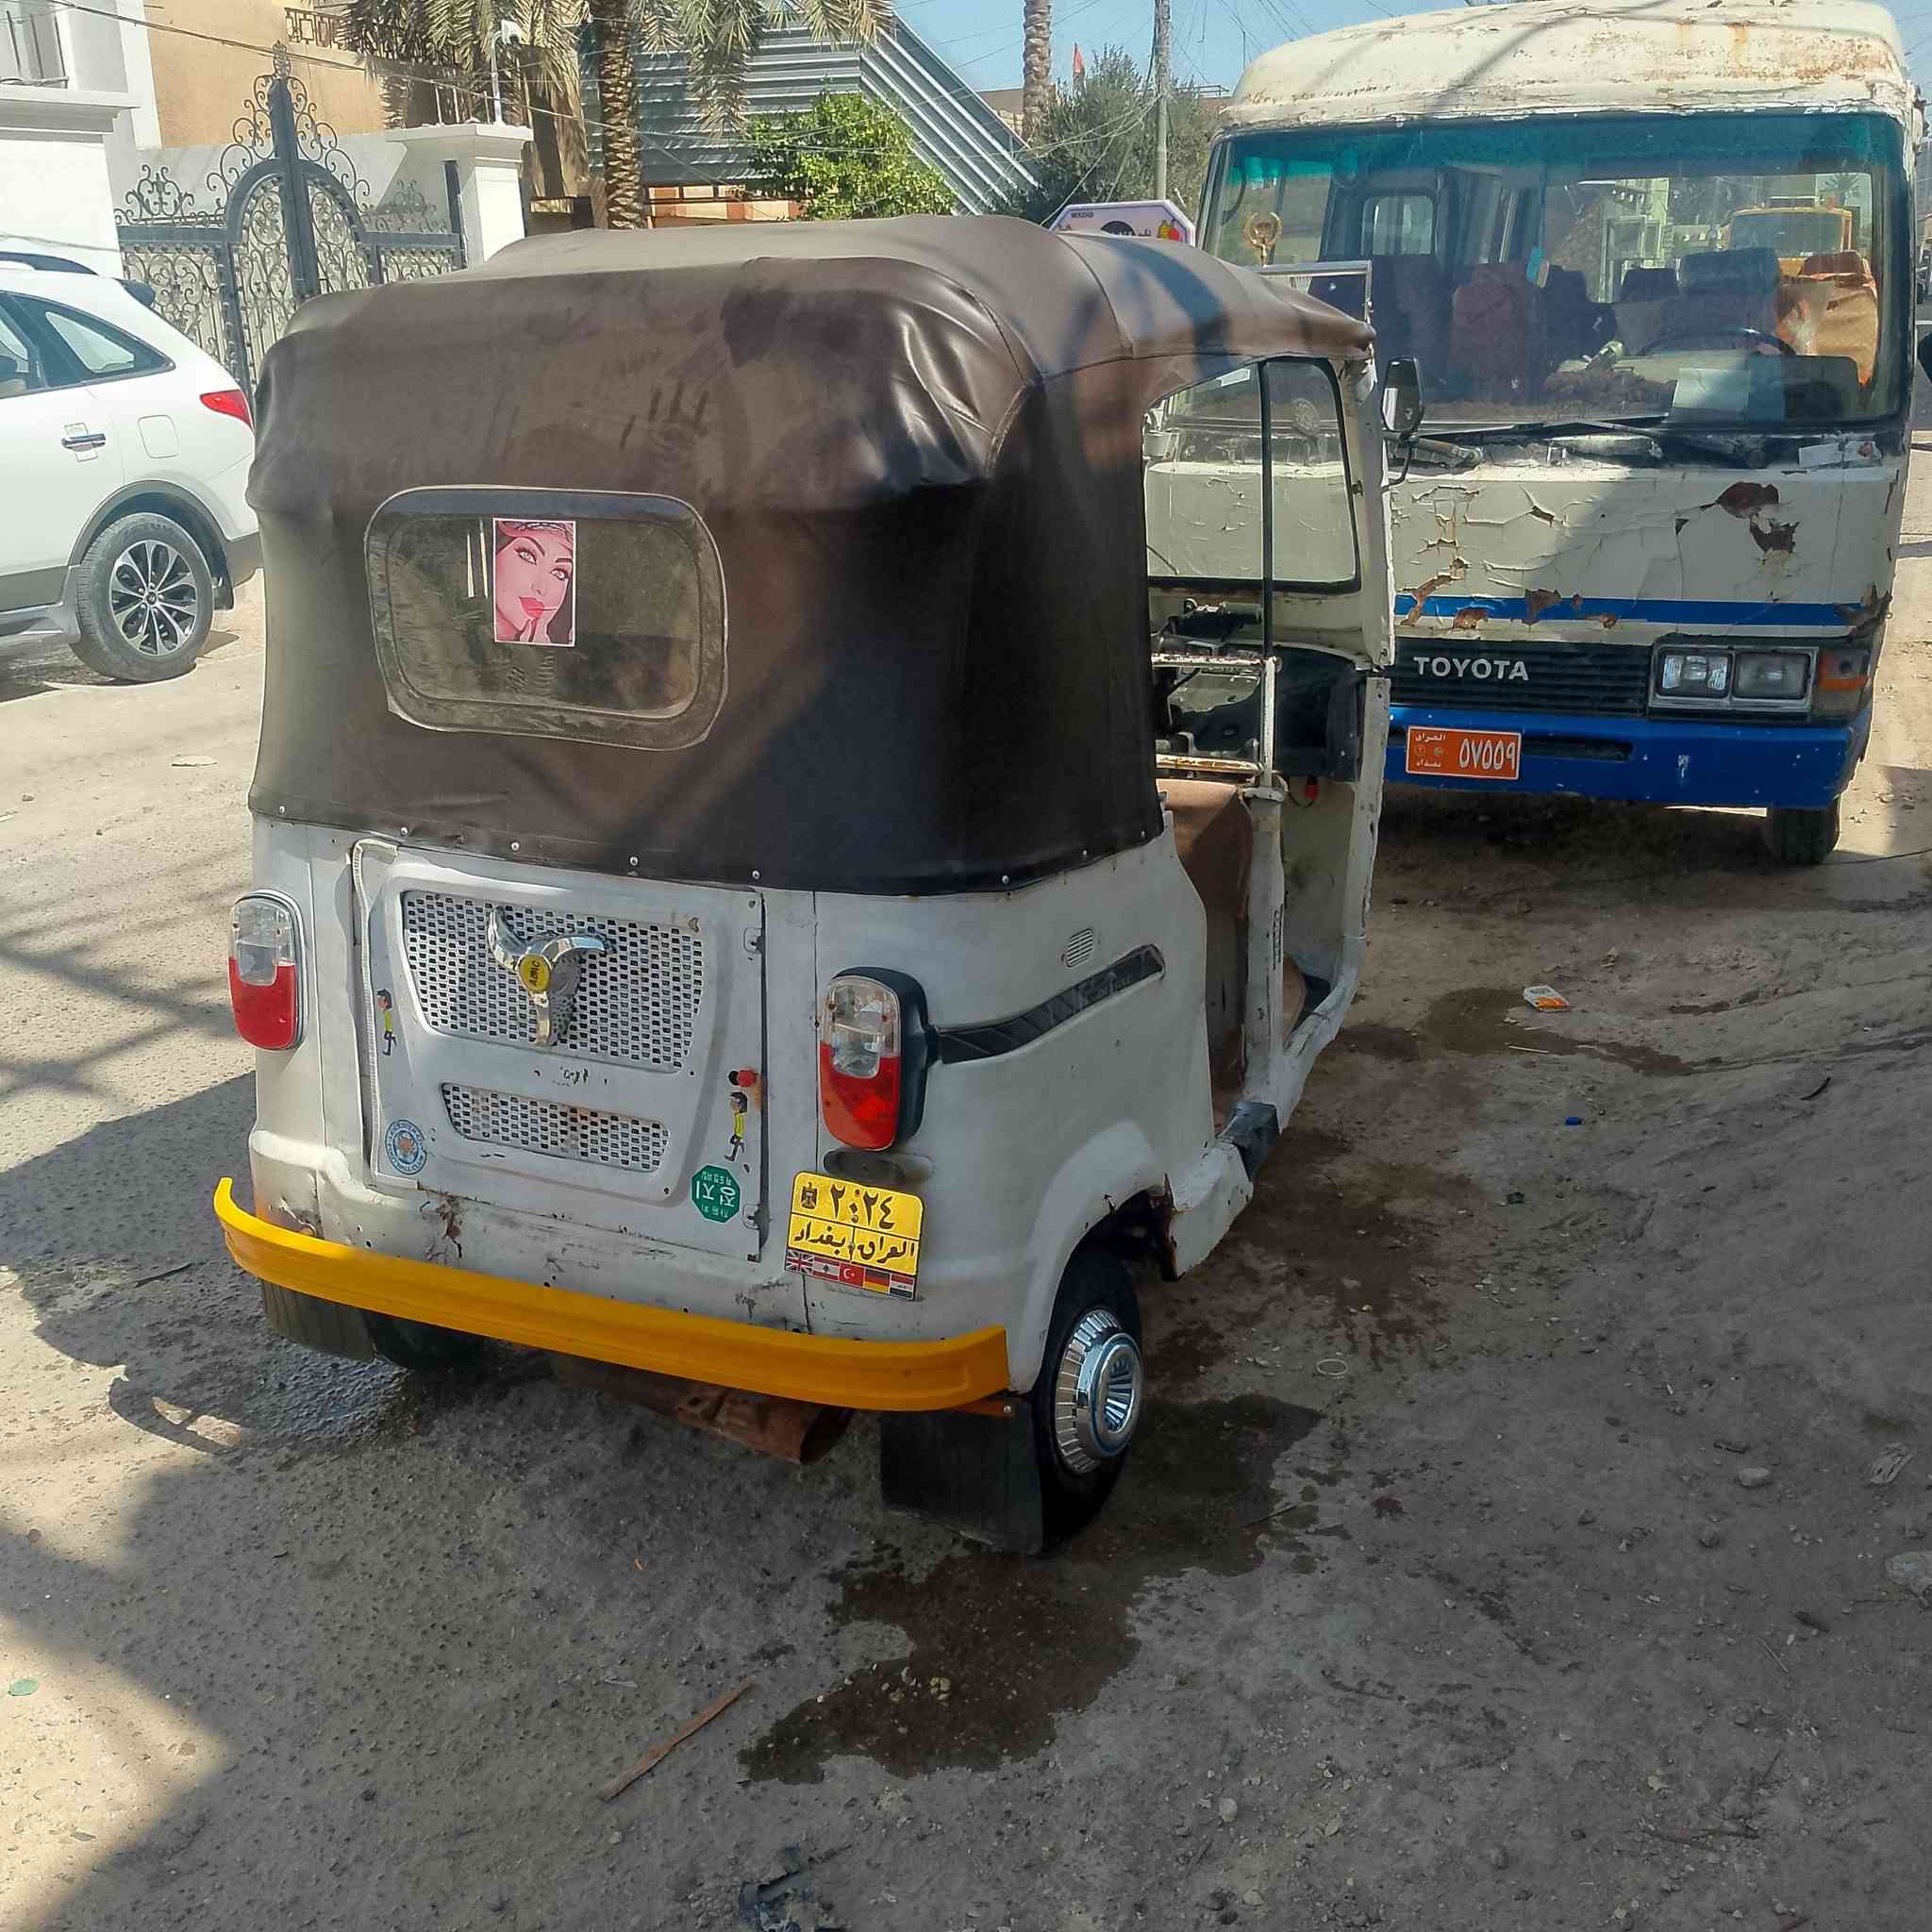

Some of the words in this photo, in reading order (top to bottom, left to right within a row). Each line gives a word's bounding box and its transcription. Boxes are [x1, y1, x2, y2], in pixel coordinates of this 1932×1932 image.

[1413, 657, 1529, 681] TOYOTA
[1458, 739, 1516, 771] ٥٧٥٥٩
[794, 1222, 846, 1256] بغداد
[858, 1237, 914, 1263] العراق
